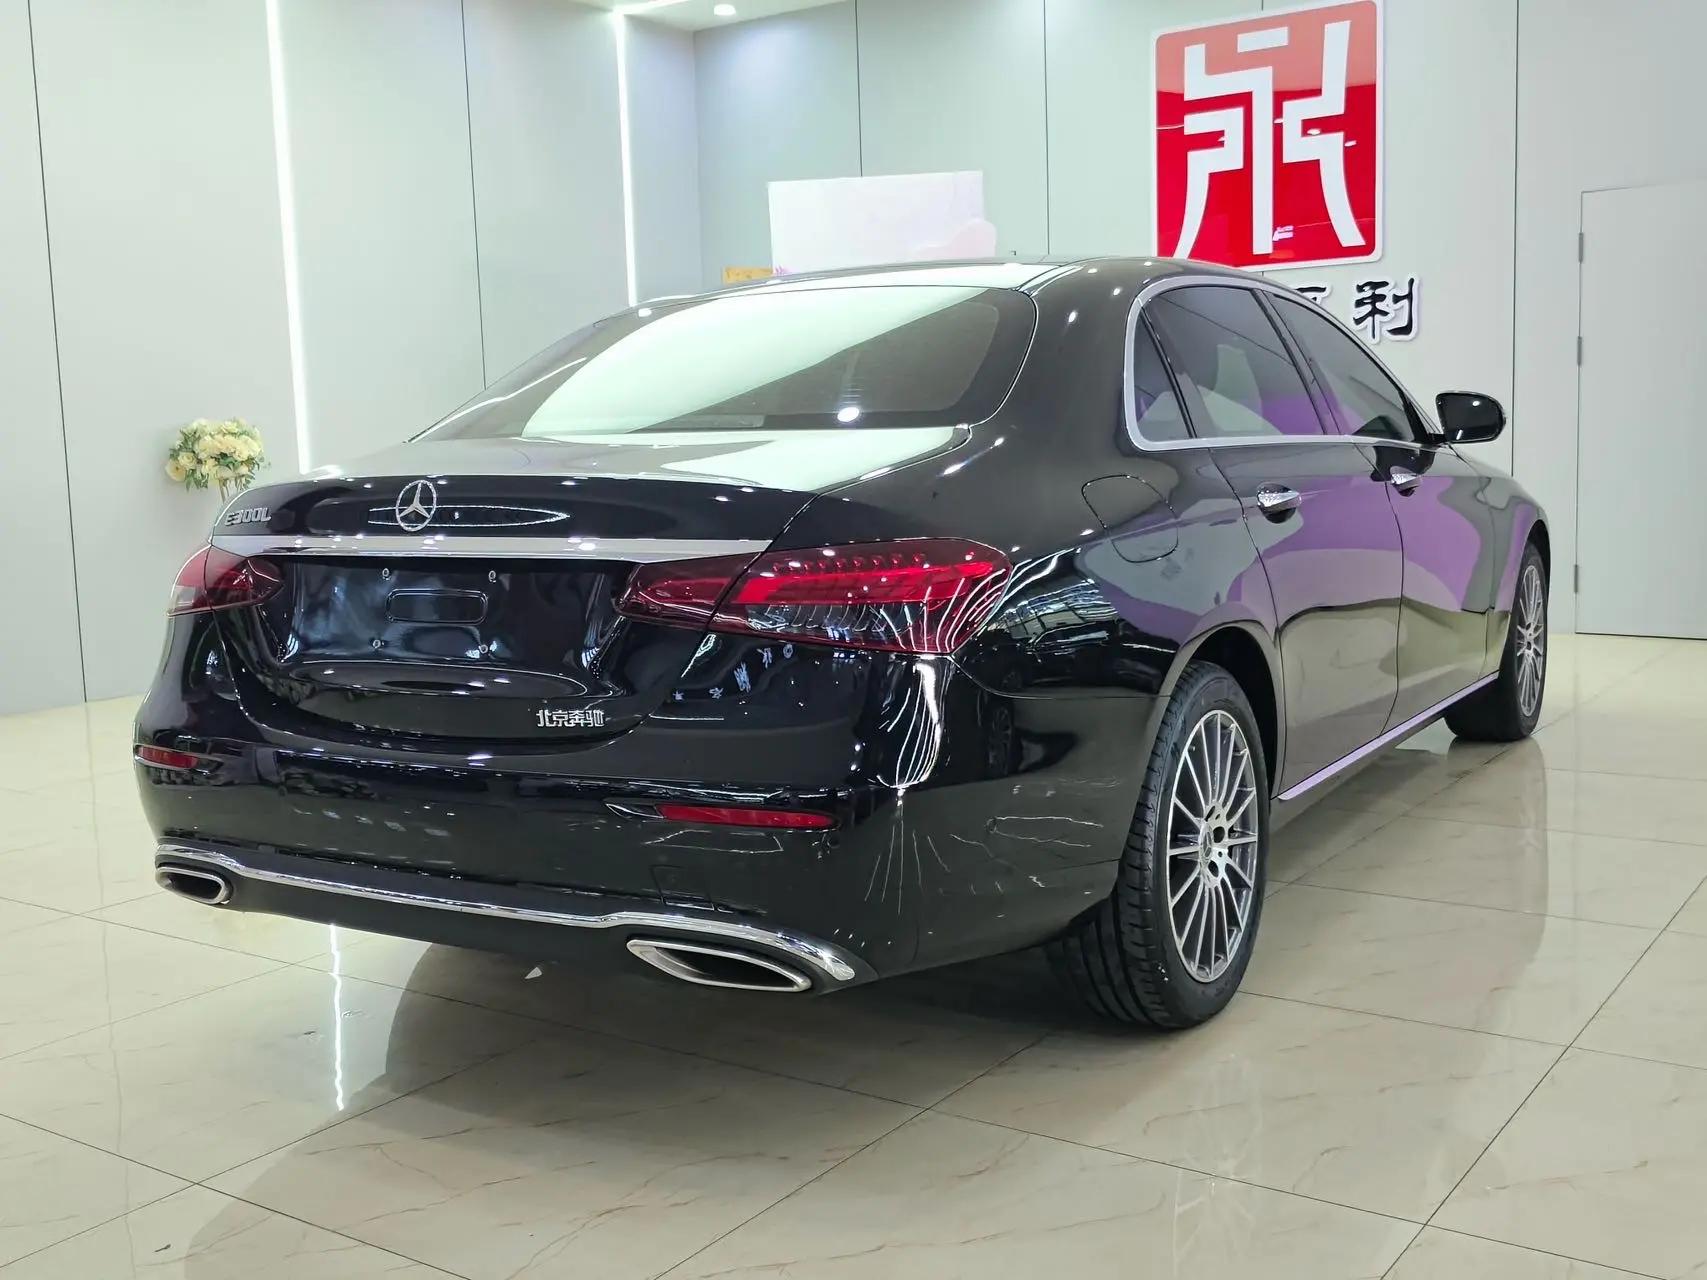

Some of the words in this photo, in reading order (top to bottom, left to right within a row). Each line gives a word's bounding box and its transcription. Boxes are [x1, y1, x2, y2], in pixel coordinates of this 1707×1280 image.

[1294, 277, 1416, 340] 利
[224, 507, 272, 527] E300L
[536, 709, 605, 727] 北京奔驰
